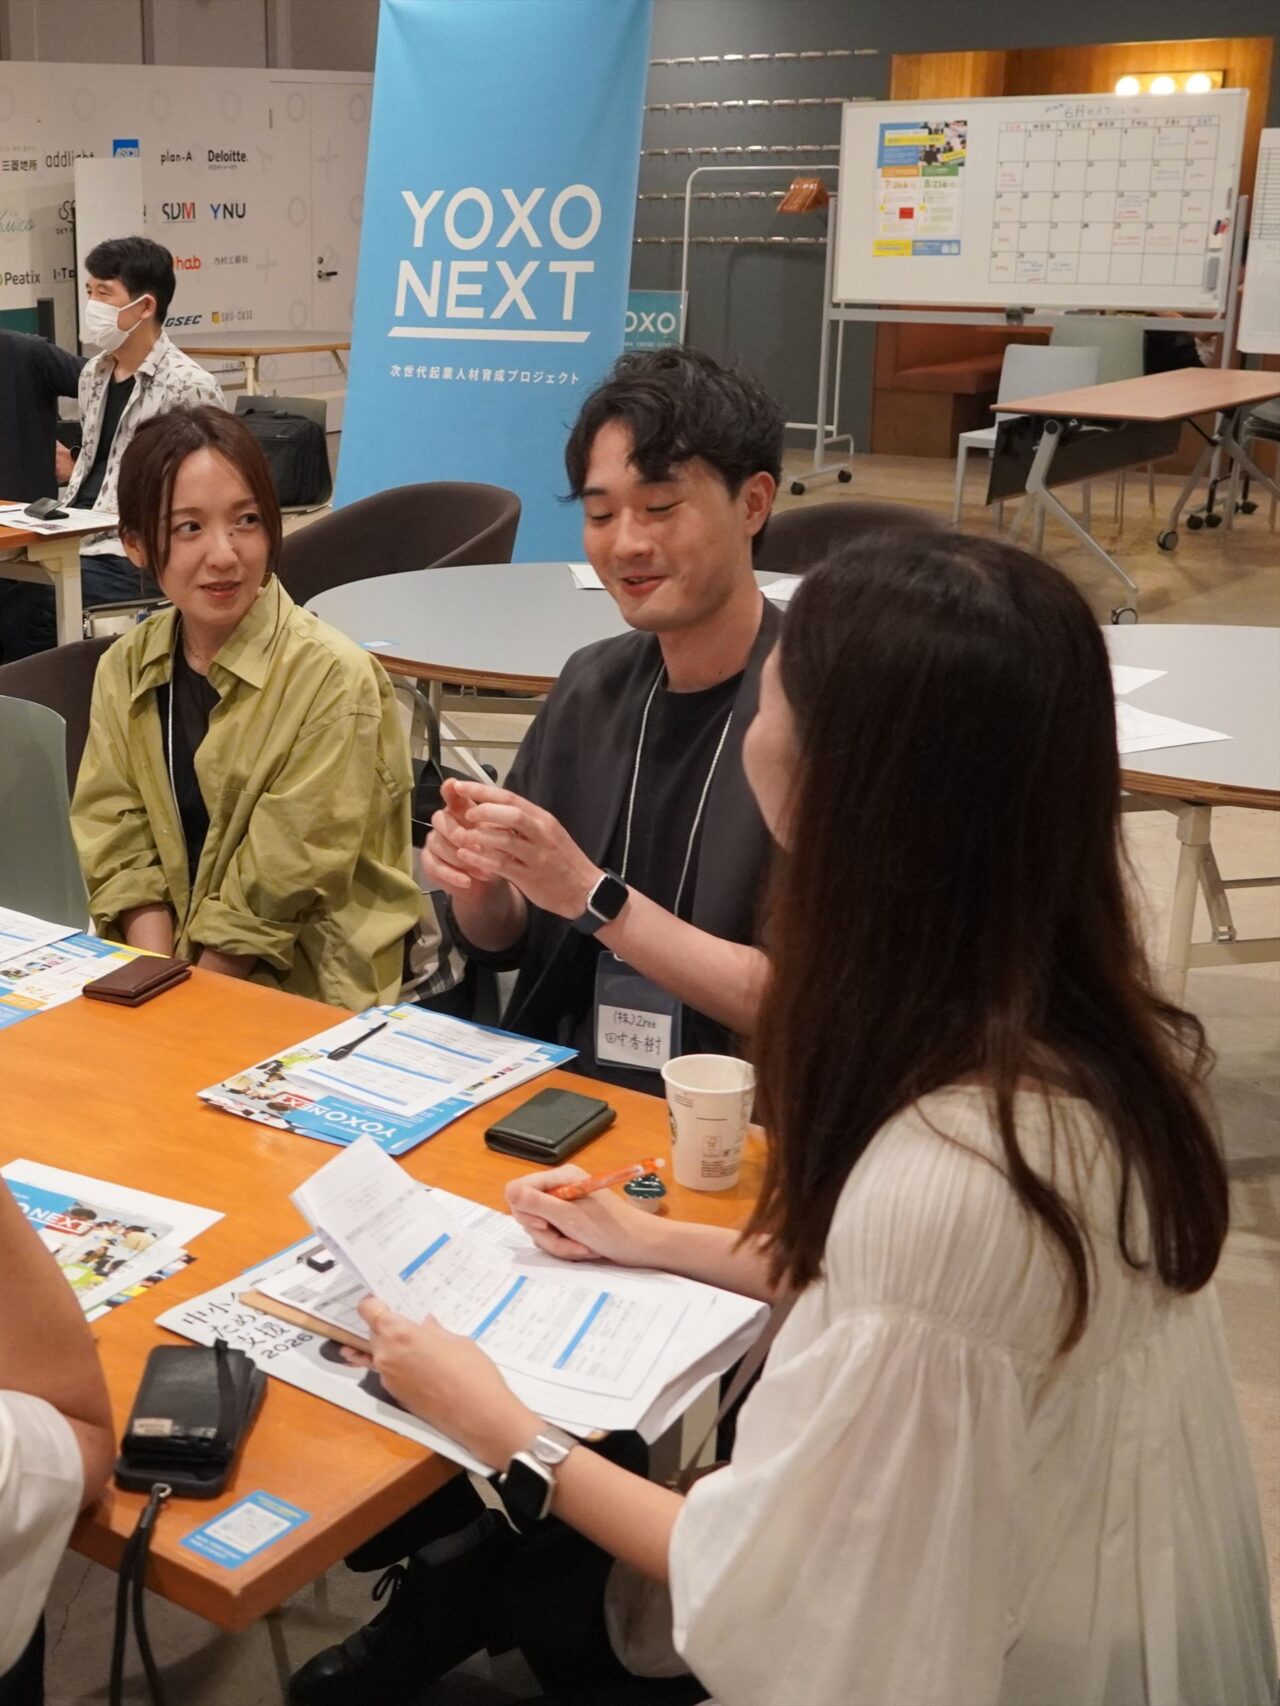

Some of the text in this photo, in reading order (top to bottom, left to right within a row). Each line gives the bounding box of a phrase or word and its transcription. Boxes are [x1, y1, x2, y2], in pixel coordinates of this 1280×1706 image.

[1, 160, 38, 171] 三菱地所
[160, 149, 193, 166] plan-A
[210, 203, 246, 219] YNU
[401, 184, 602, 250] YOXO
[5, 269, 41, 285] Peatix
[394, 260, 594, 320] NEXT
[390, 364, 580, 385] 次世代起業人材育成プロジェクト
[261, 1332, 313, 1360] 2026
